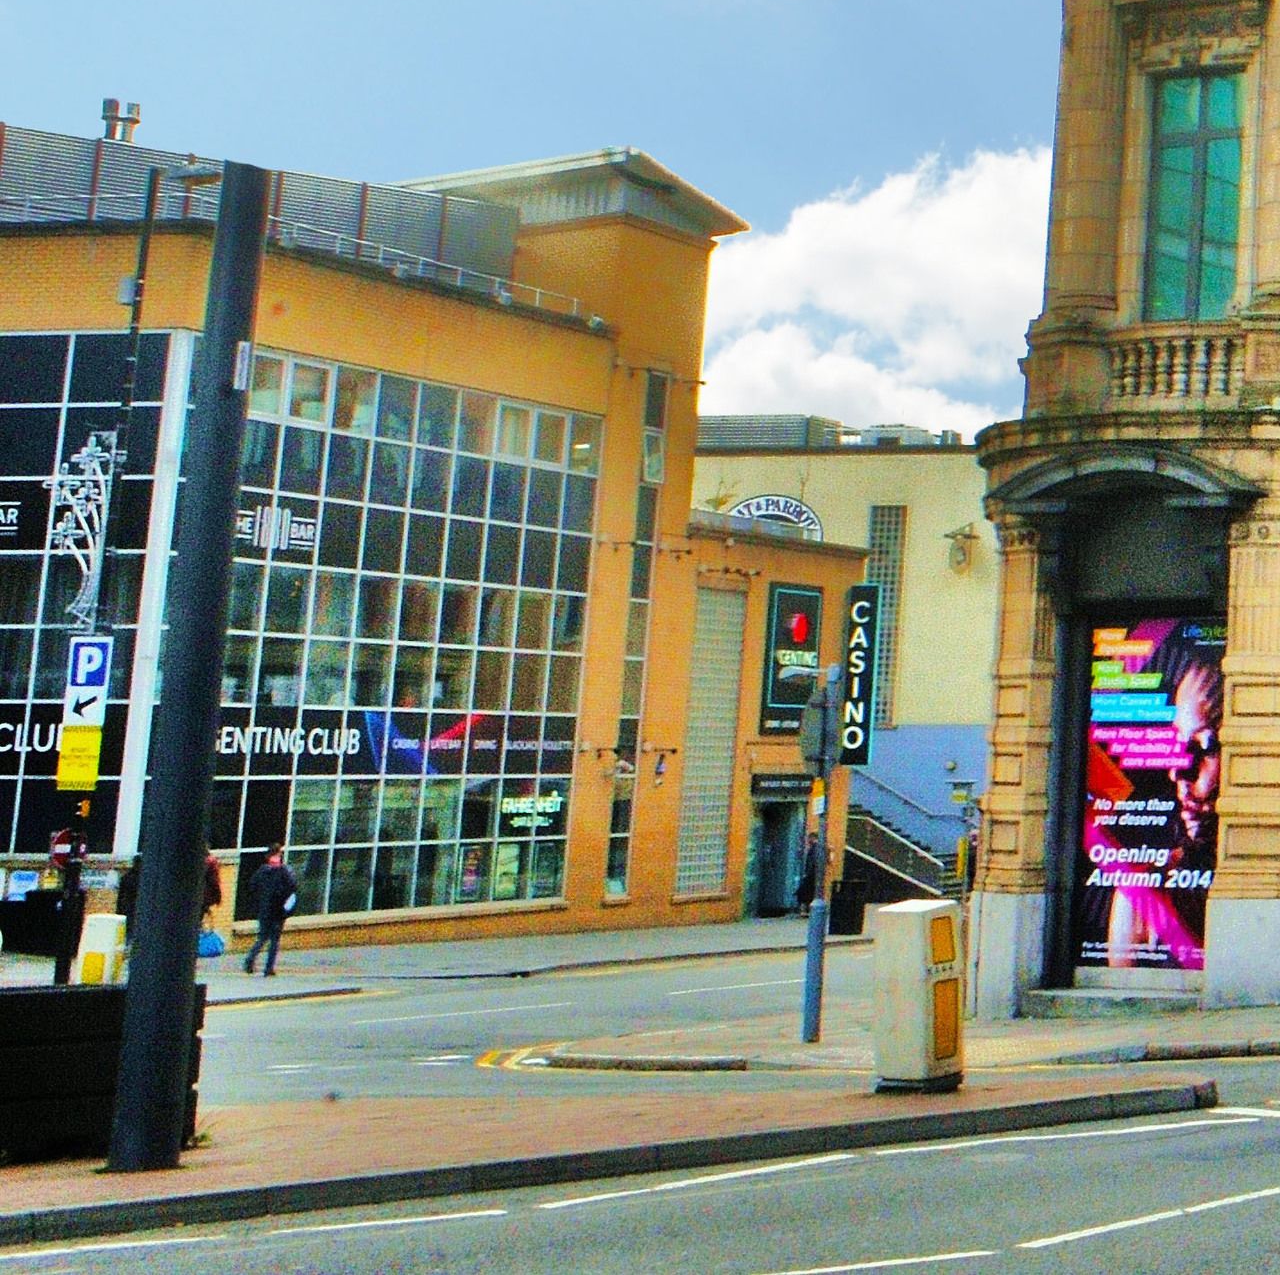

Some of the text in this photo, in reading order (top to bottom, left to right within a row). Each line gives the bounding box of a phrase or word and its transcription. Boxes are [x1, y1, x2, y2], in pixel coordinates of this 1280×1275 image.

[76, 645, 104, 685] P
[842, 600, 871, 750] CASINO
[0, 722, 63, 753] CLU
[307, 727, 361, 755] CLUB
[1093, 798, 1175, 811] No more than
[1093, 812, 1168, 828] you deserve
[1089, 844, 1169, 867] Opening
[1086, 868, 1213, 889] Autumn 2014
